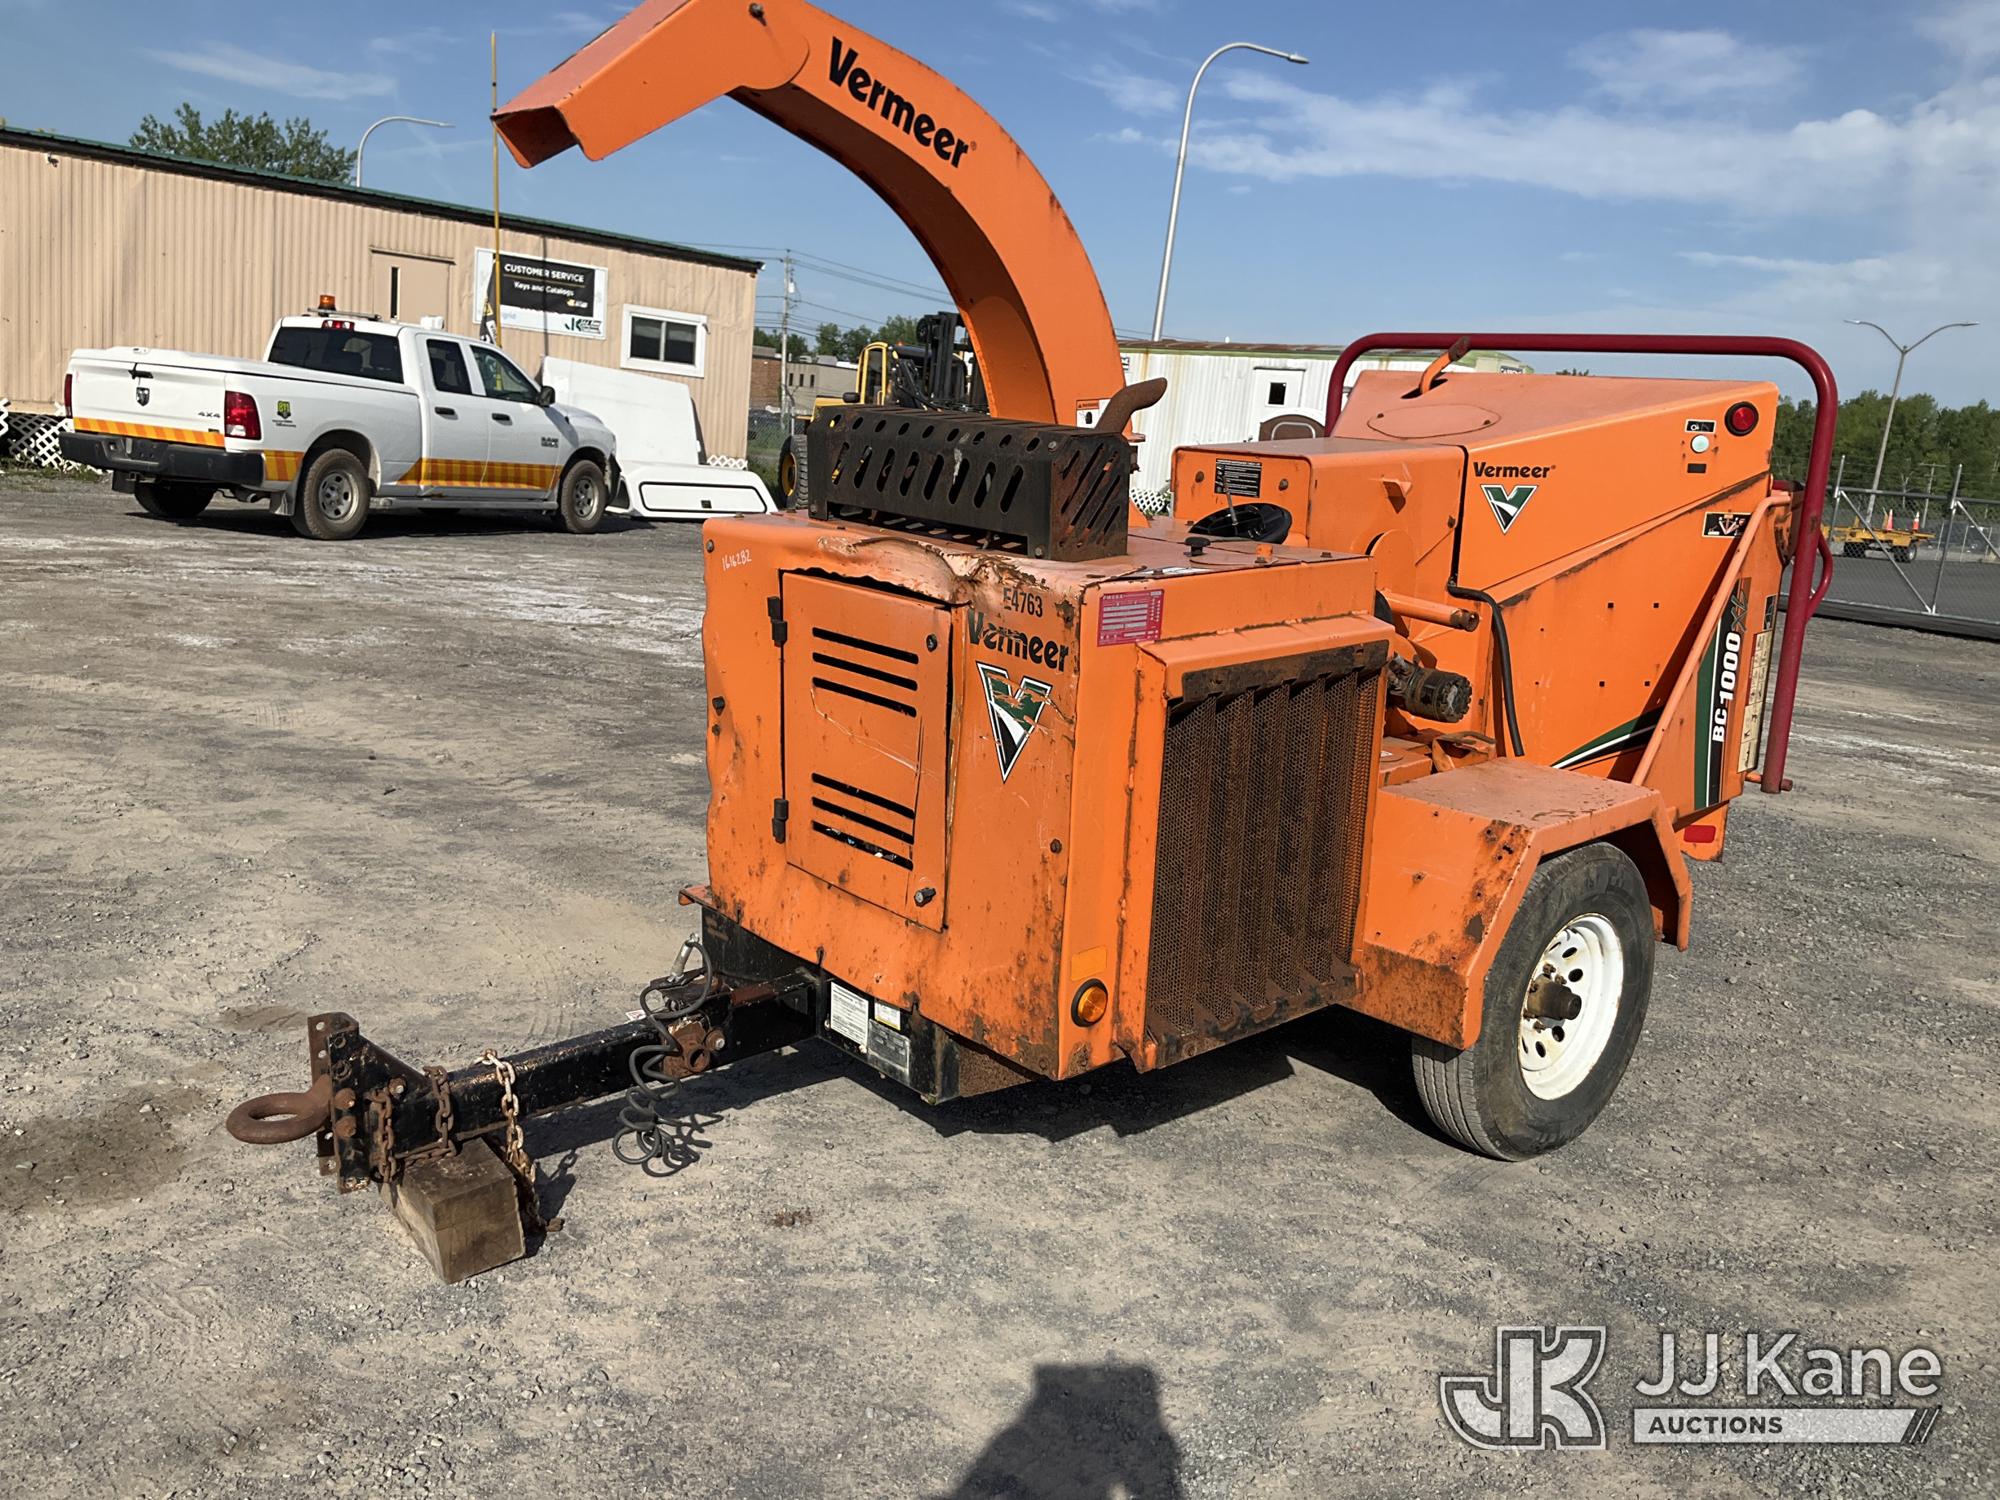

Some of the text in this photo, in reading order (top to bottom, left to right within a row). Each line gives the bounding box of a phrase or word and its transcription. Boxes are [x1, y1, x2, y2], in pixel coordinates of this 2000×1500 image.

[829, 36, 969, 168] Vermeer
[504, 263, 585, 283] CUSTOMER SERVICE
[513, 281, 530, 291] Keys
[545, 286, 575, 297] Catalogs
[1473, 461, 1551, 479] Vermeer
[1003, 586, 1043, 618] E4763
[967, 606, 1069, 673] Vermeer
[1720, 631, 1741, 701] 1000
